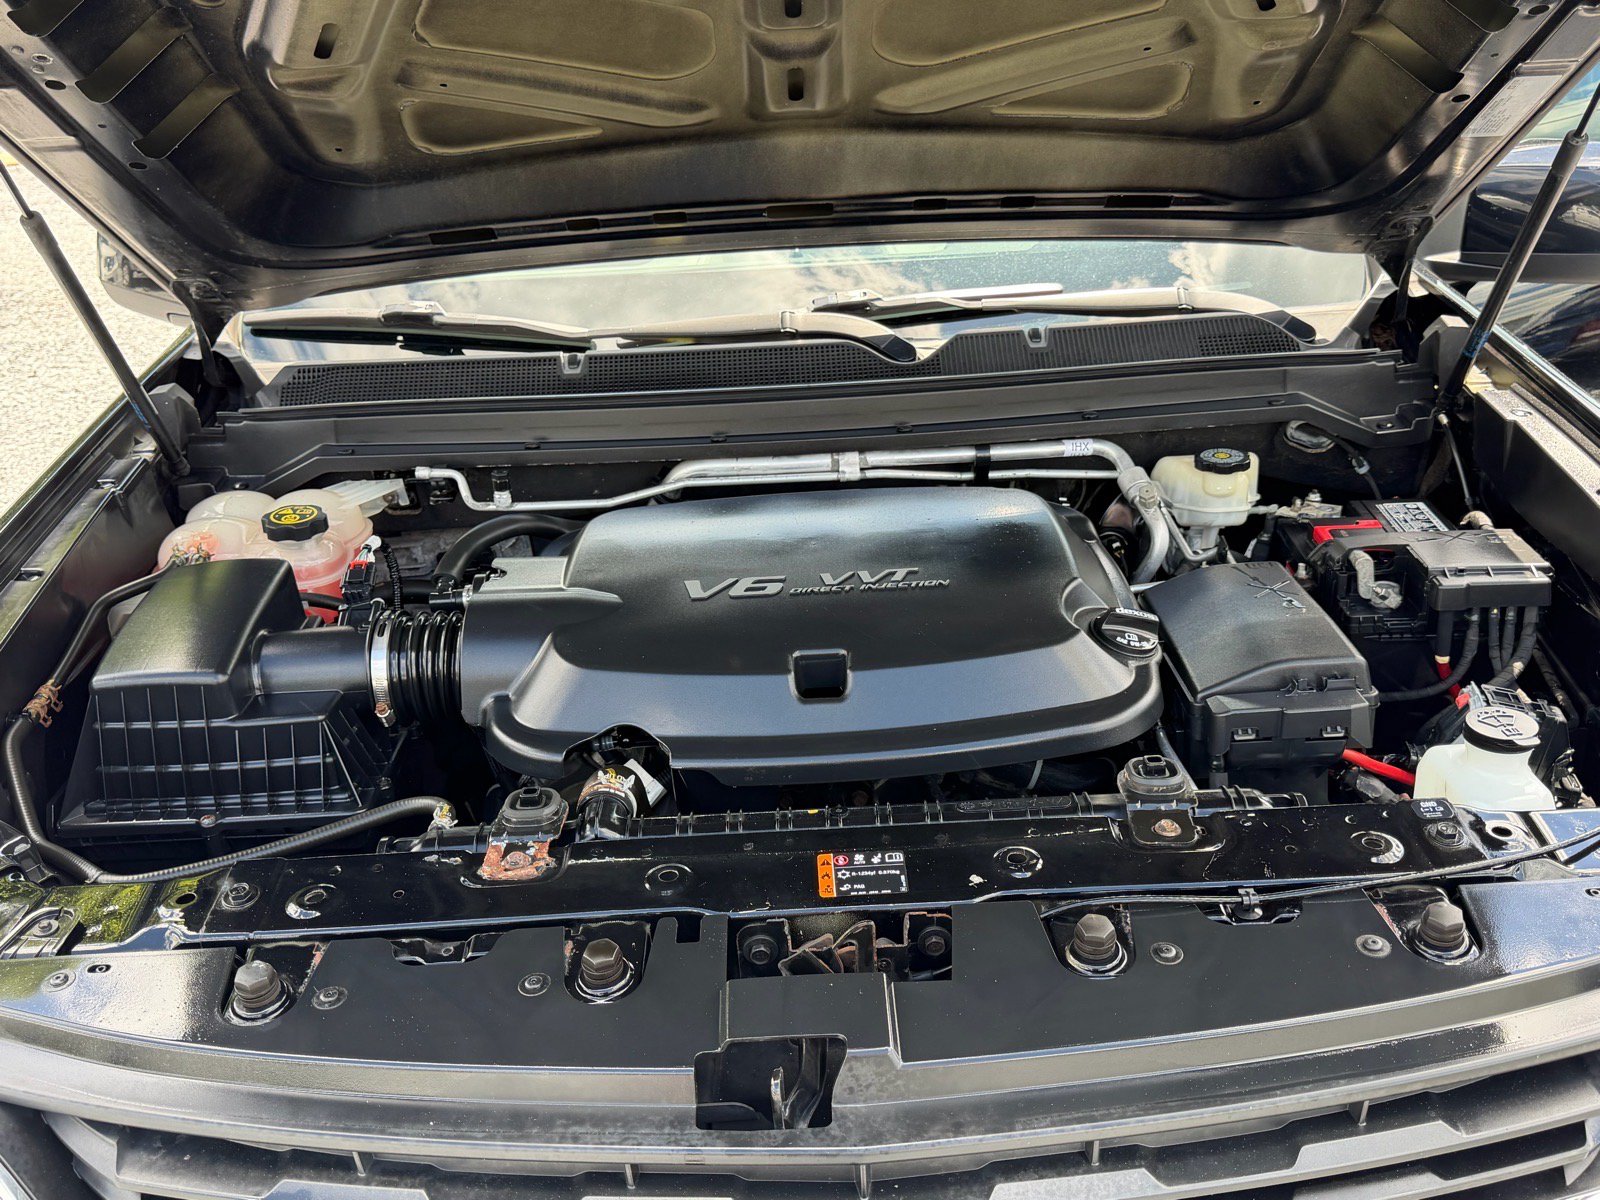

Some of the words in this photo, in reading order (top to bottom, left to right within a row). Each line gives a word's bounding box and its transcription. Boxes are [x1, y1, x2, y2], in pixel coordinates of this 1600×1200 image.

[684, 575, 786, 601] V6
[819, 567, 919, 586] VVT
[789, 585, 854, 595] DIRECT
[860, 579, 950, 591] INJECTION
